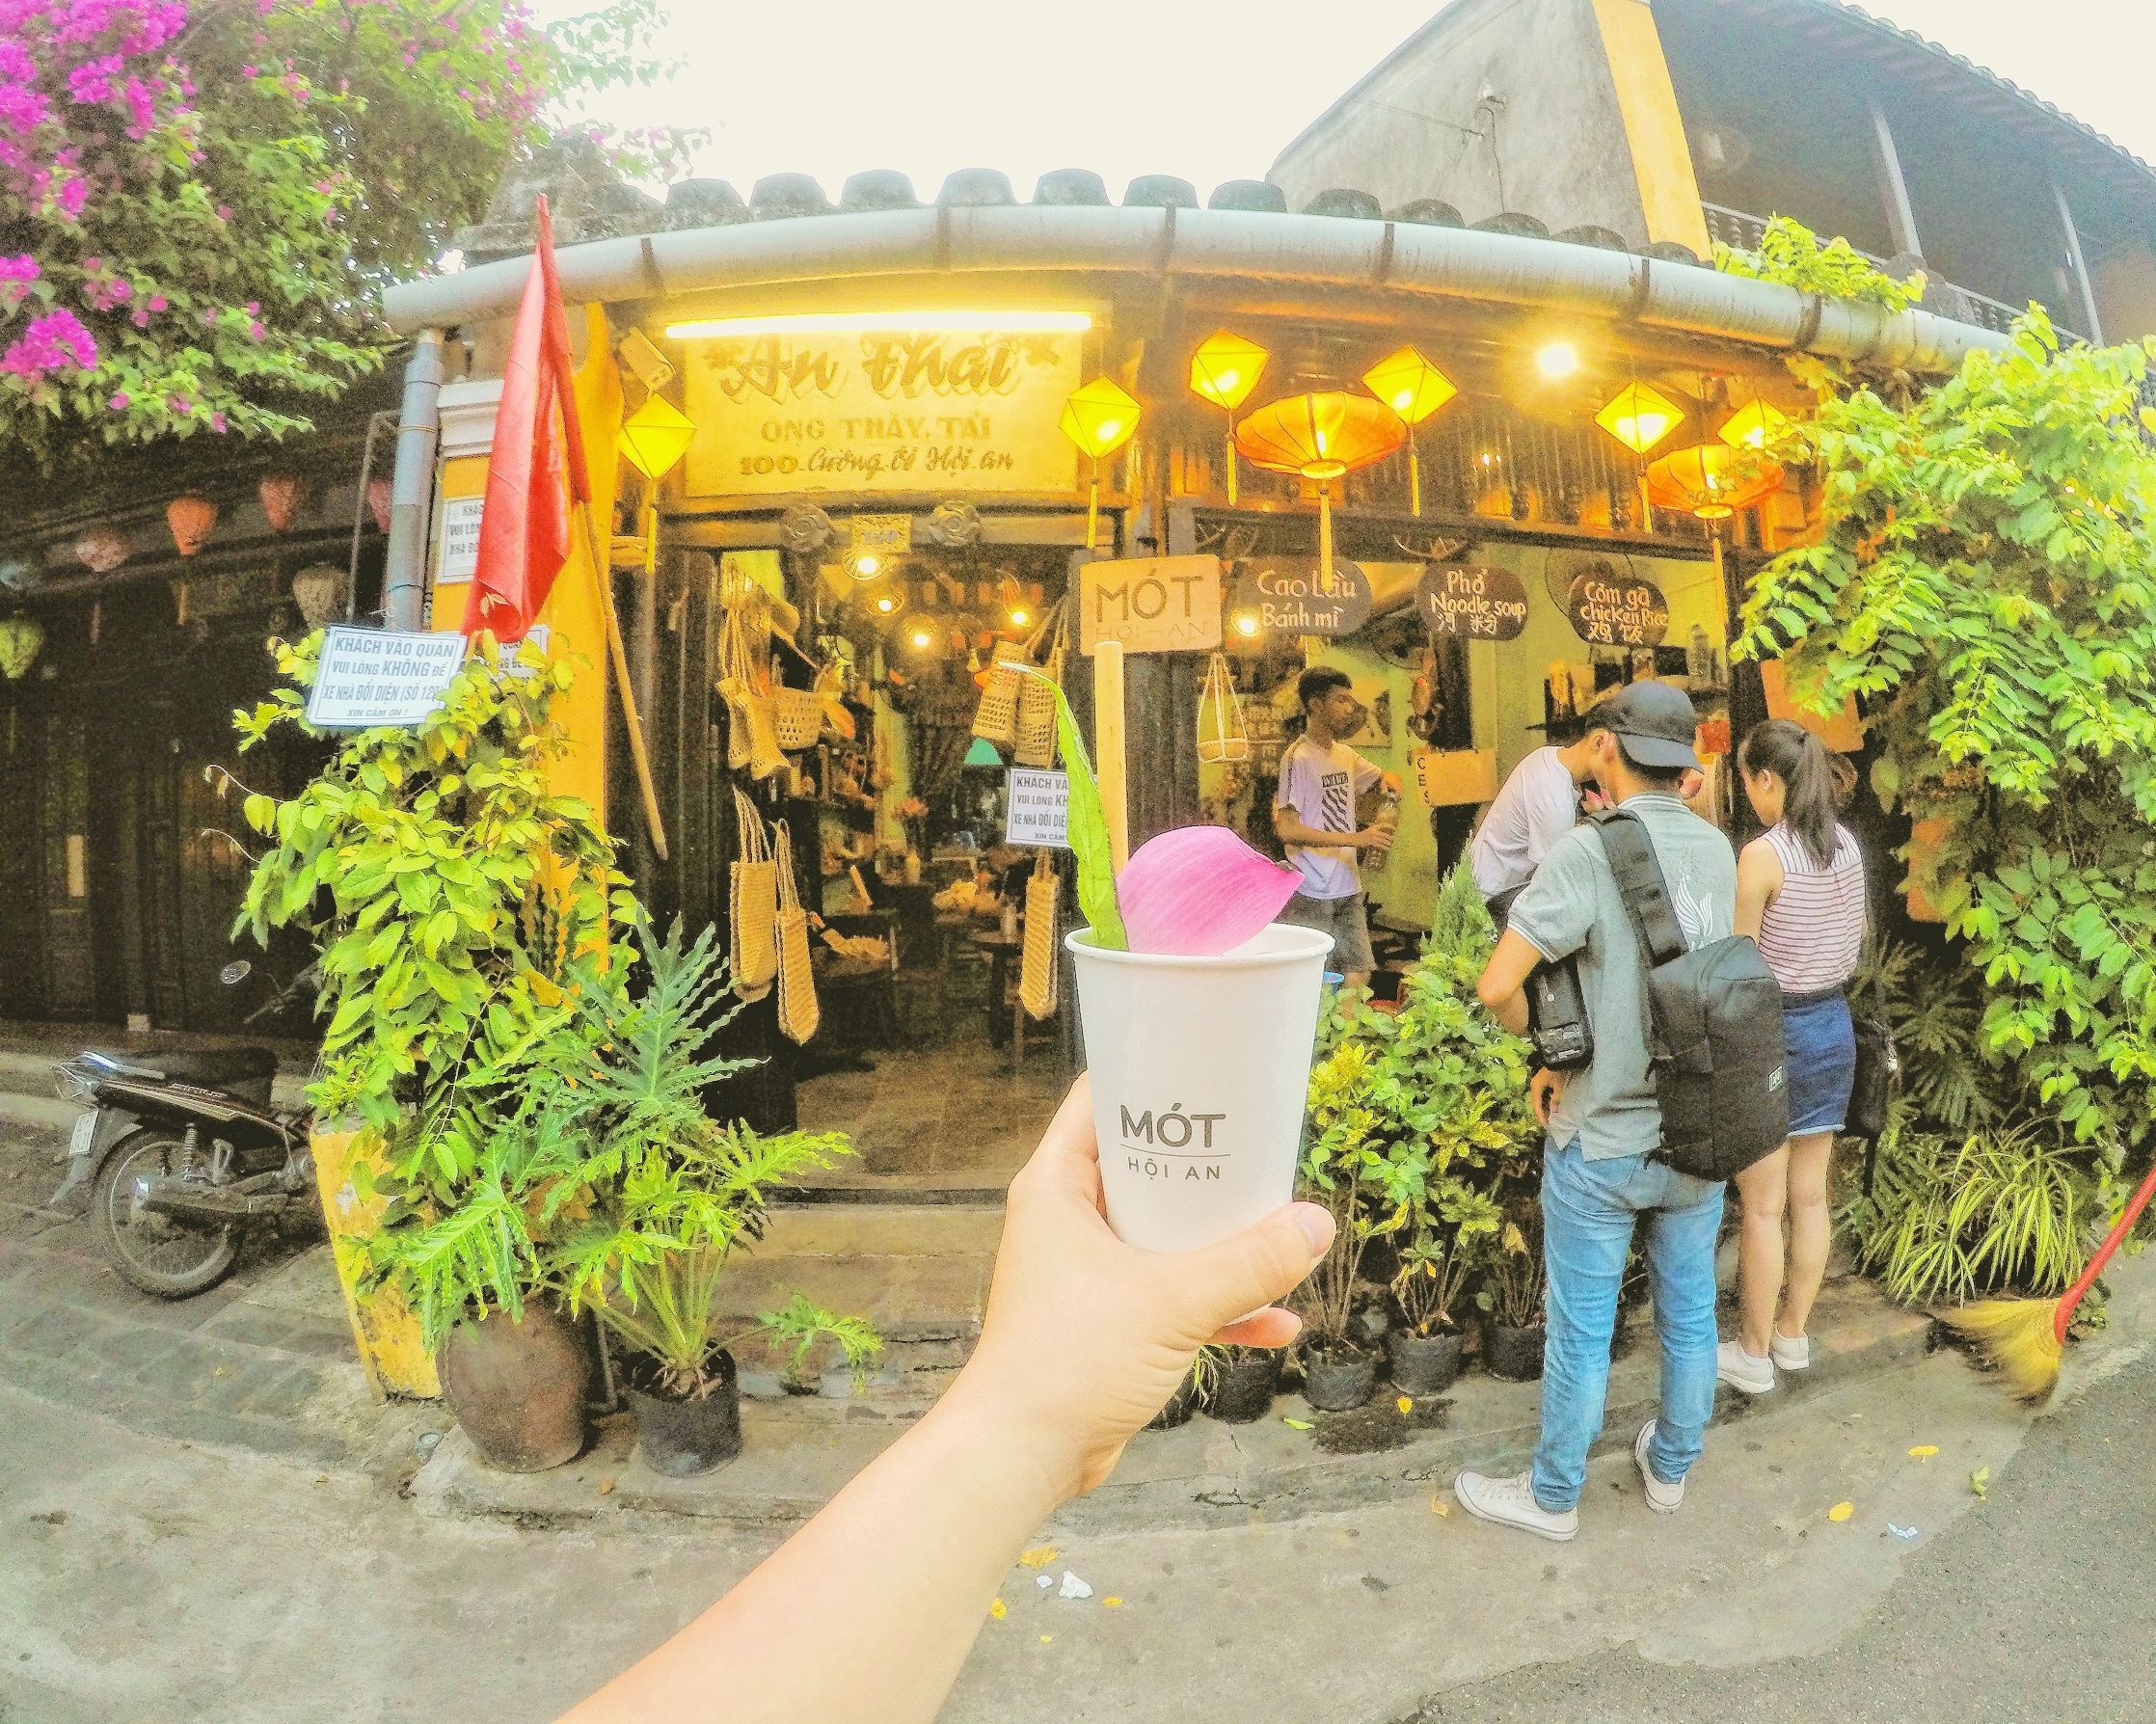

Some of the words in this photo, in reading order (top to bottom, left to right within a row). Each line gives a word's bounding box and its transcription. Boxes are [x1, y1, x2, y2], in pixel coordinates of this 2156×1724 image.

[1256, 569, 1308, 597] Cao
[1096, 569, 1203, 622] MÓT
[1430, 590, 1491, 615] Noodle
[1493, 600, 1527, 623] soup
[1261, 602, 1309, 628] Bánh
[1314, 606, 1344, 628] mì
[1169, 622, 1205, 638] AN
[335, 636, 382, 654] KHÁCH
[386, 639, 413, 656] VÀO
[416, 641, 455, 658] QUÁN
[333, 660, 350, 673] VUI
[351, 660, 380, 675] LÒNG
[382, 659, 432, 676] KHÔNG
[1016, 775, 1052, 790] KHÁCH
[1055, 776, 1068, 790] VÀ
[1017, 795, 1030, 804] VUI
[1054, 812, 1066, 830] DIỆ
[1120, 1103, 1226, 1147] MÓT
[1128, 1157, 1169, 1180] HỘI
[1185, 1166, 1221, 1179] AN
